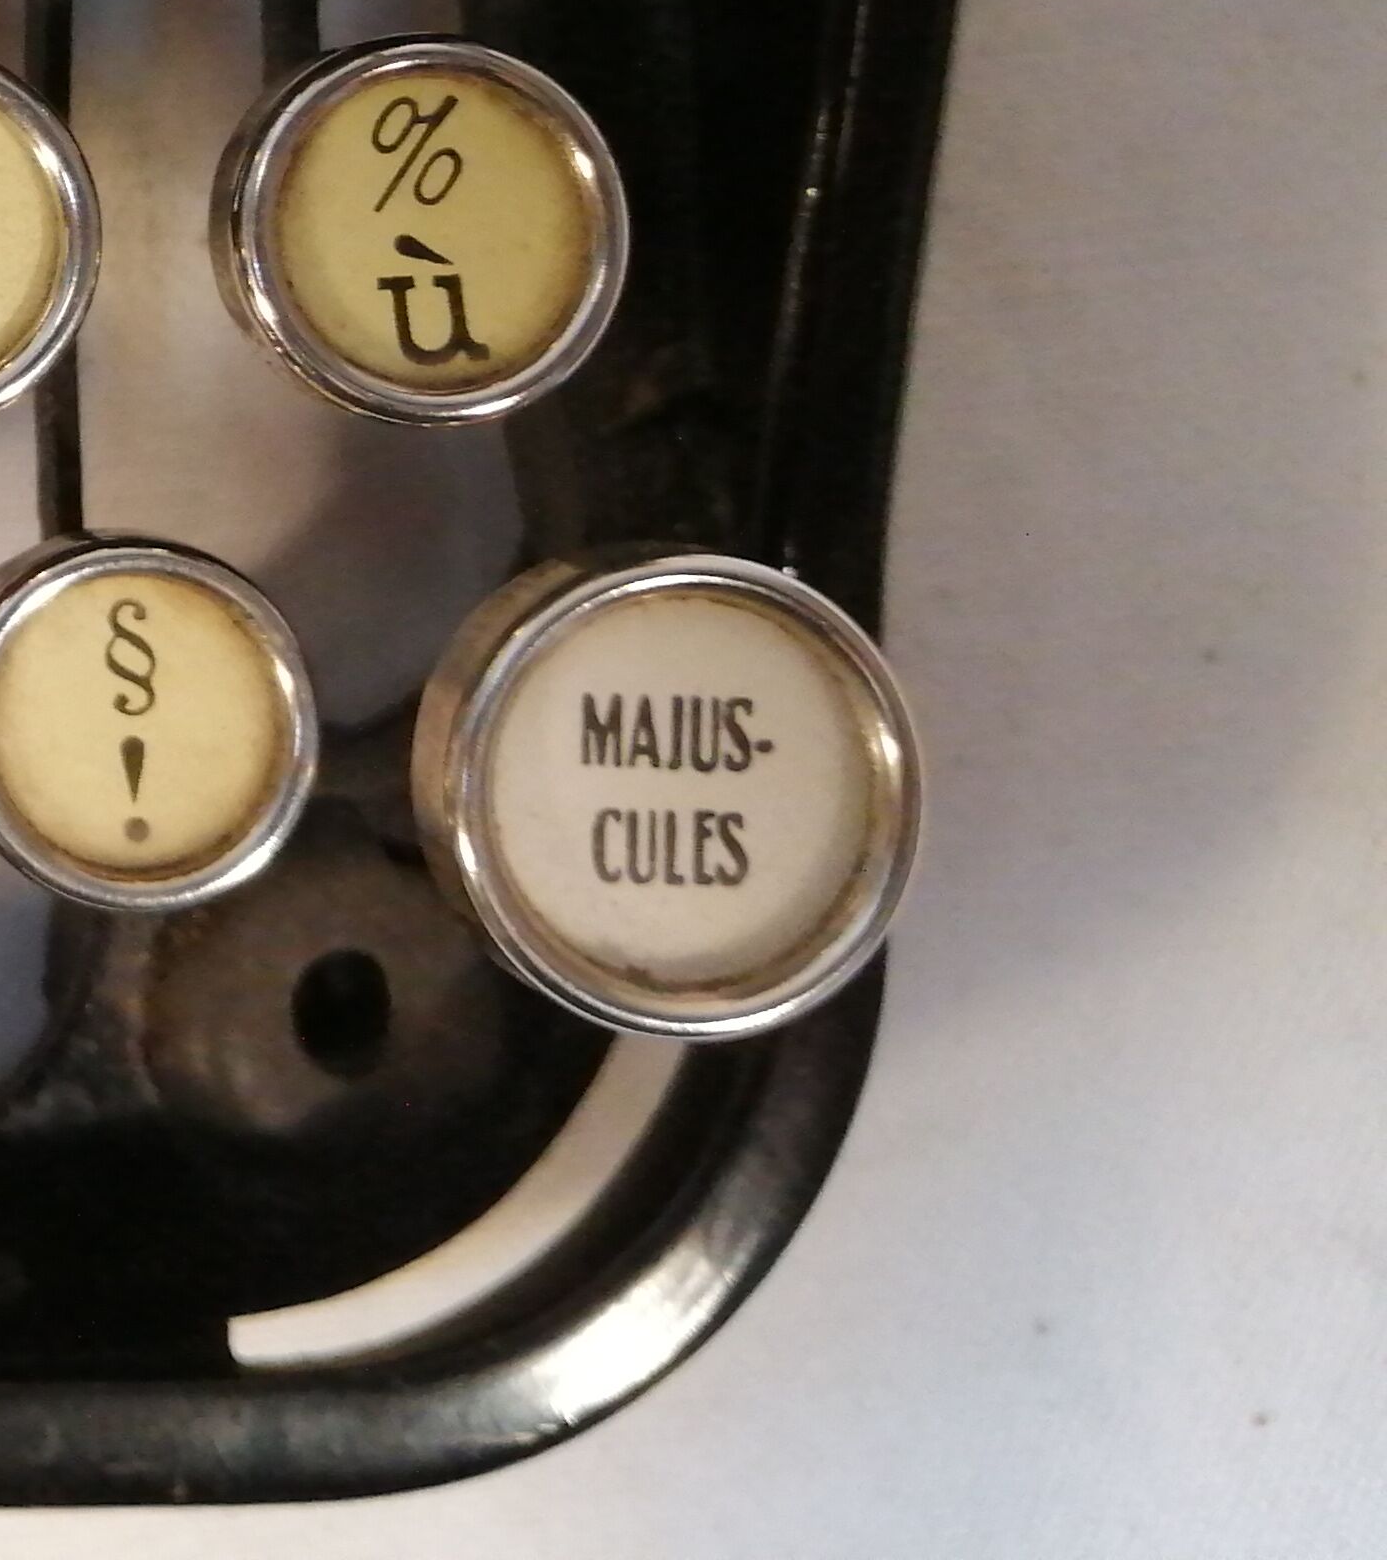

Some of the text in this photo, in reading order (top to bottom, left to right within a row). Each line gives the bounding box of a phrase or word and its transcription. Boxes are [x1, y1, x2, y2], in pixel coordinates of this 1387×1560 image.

[371, 94, 464, 213] %
[377, 234, 490, 367] ù
[582, 692, 775, 774] MAJUS-
[119, 735, 151, 844] !
[592, 807, 750, 888] CULES
